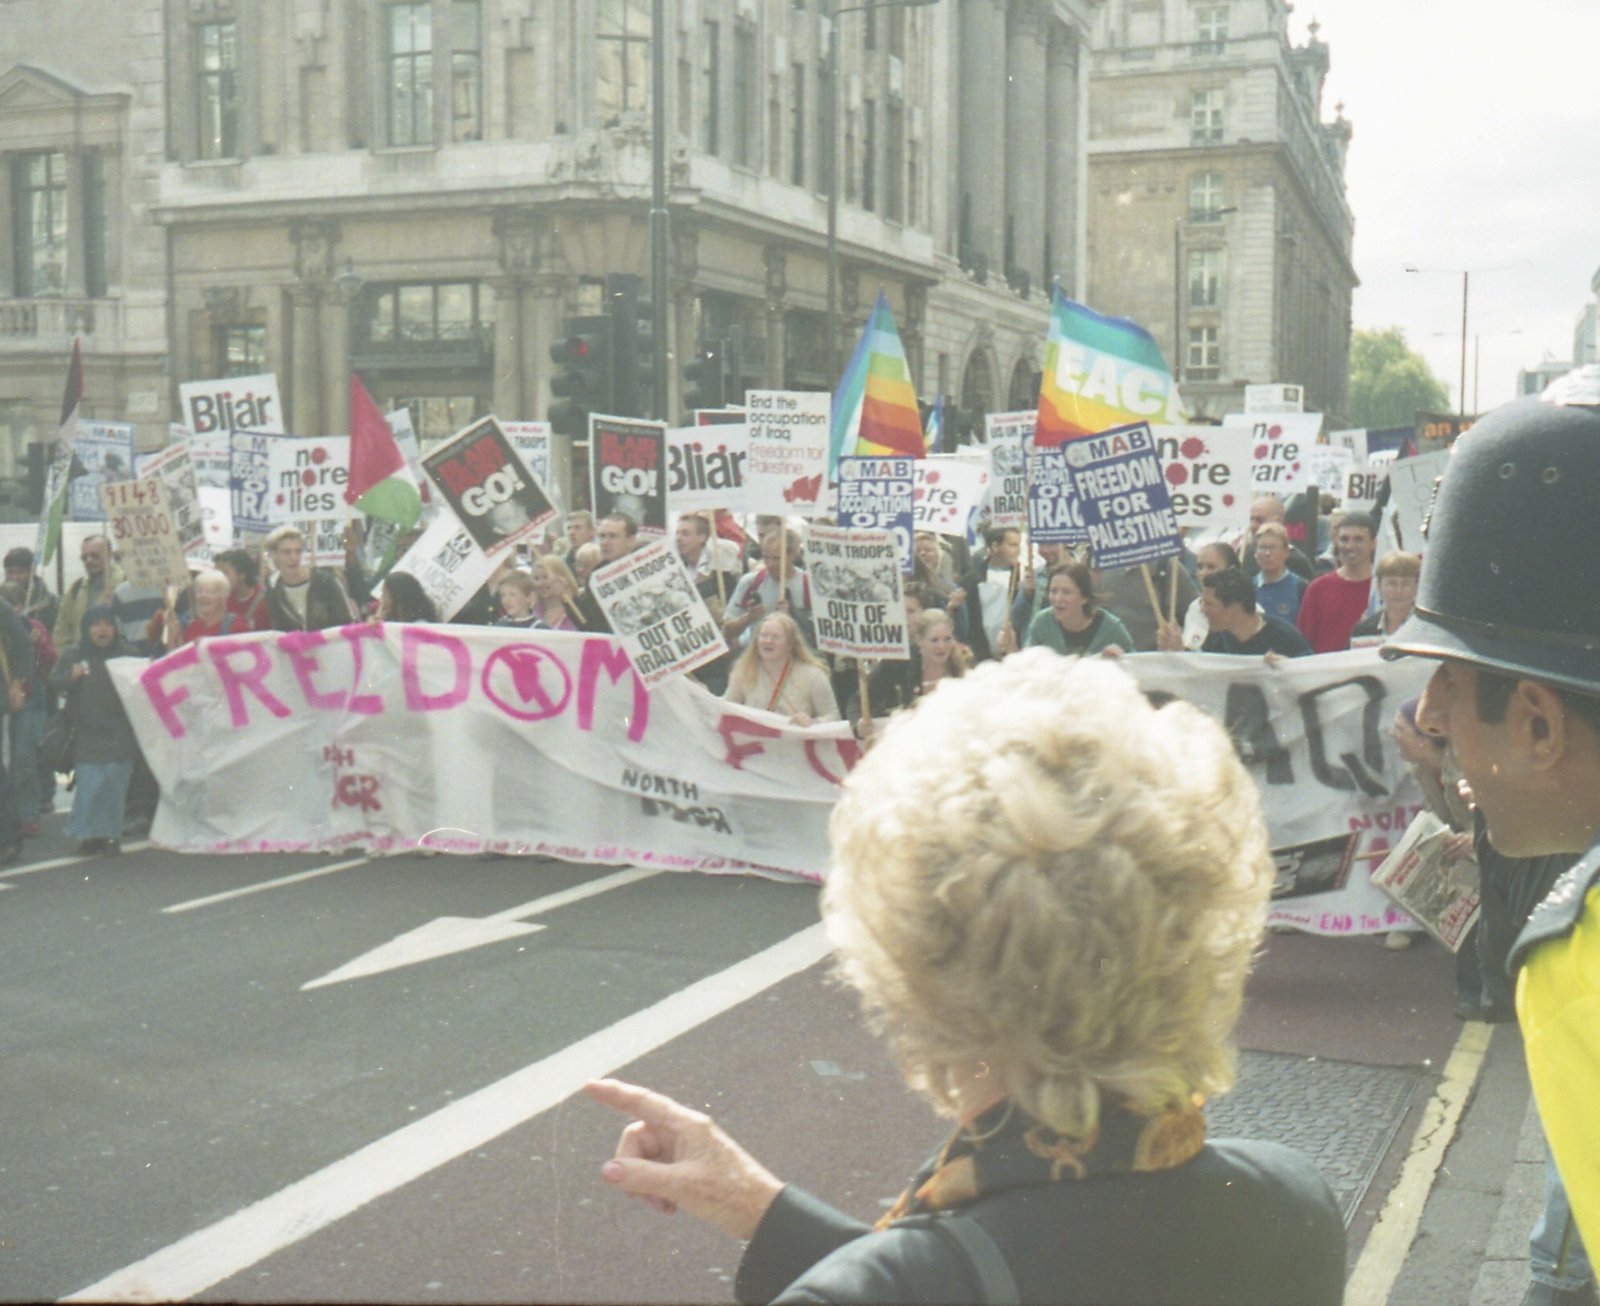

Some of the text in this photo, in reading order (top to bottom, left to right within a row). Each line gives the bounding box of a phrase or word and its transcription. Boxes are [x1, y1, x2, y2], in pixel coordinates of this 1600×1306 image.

[190, 391, 271, 433] Bliar
[750, 394, 797, 409] End the
[750, 410, 826, 426] occupation
[750, 425, 791, 442] of Iraq
[1089, 431, 1147, 460] MAB
[749, 443, 826, 460] Freedom for
[1025, 455, 1066, 471] EN
[1254, 443, 1298, 463] ore
[668, 442, 746, 491] Bliar
[749, 459, 804, 474] Palestine
[861, 462, 908, 477] MAB
[1074, 454, 1161, 501] FREEDOM
[1165, 462, 1231, 486] ore
[461, 463, 525, 516] GO!
[601, 466, 657, 497] GO!
[840, 481, 911, 497] END
[1003, 477, 1025, 495] OU
[1038, 484, 1074, 499] OF
[1348, 473, 1382, 500] Bli
[290, 488, 335, 512] lies
[913, 487, 957, 505] ore
[1098, 491, 1151, 519] FOR
[1172, 493, 1212, 516] es
[851, 512, 898, 527] OF
[913, 506, 941, 522] ar
[810, 529, 887, 542] Socialist Worker
[1088, 508, 1178, 551] PALESTINE
[807, 540, 894, 559] US UK TROOPS
[598, 551, 677, 599] US UK TROOPS
[827, 600, 887, 624] OUT OF
[638, 610, 693, 651] OUT OF
[817, 618, 903, 643] IRAQ NOW
[634, 621, 716, 675] IRAQ NOW
[718, 714, 865, 787] FO
[621, 768, 699, 801] NORTH
[1349, 804, 1426, 831] NORT
[1319, 912, 1353, 931] END
